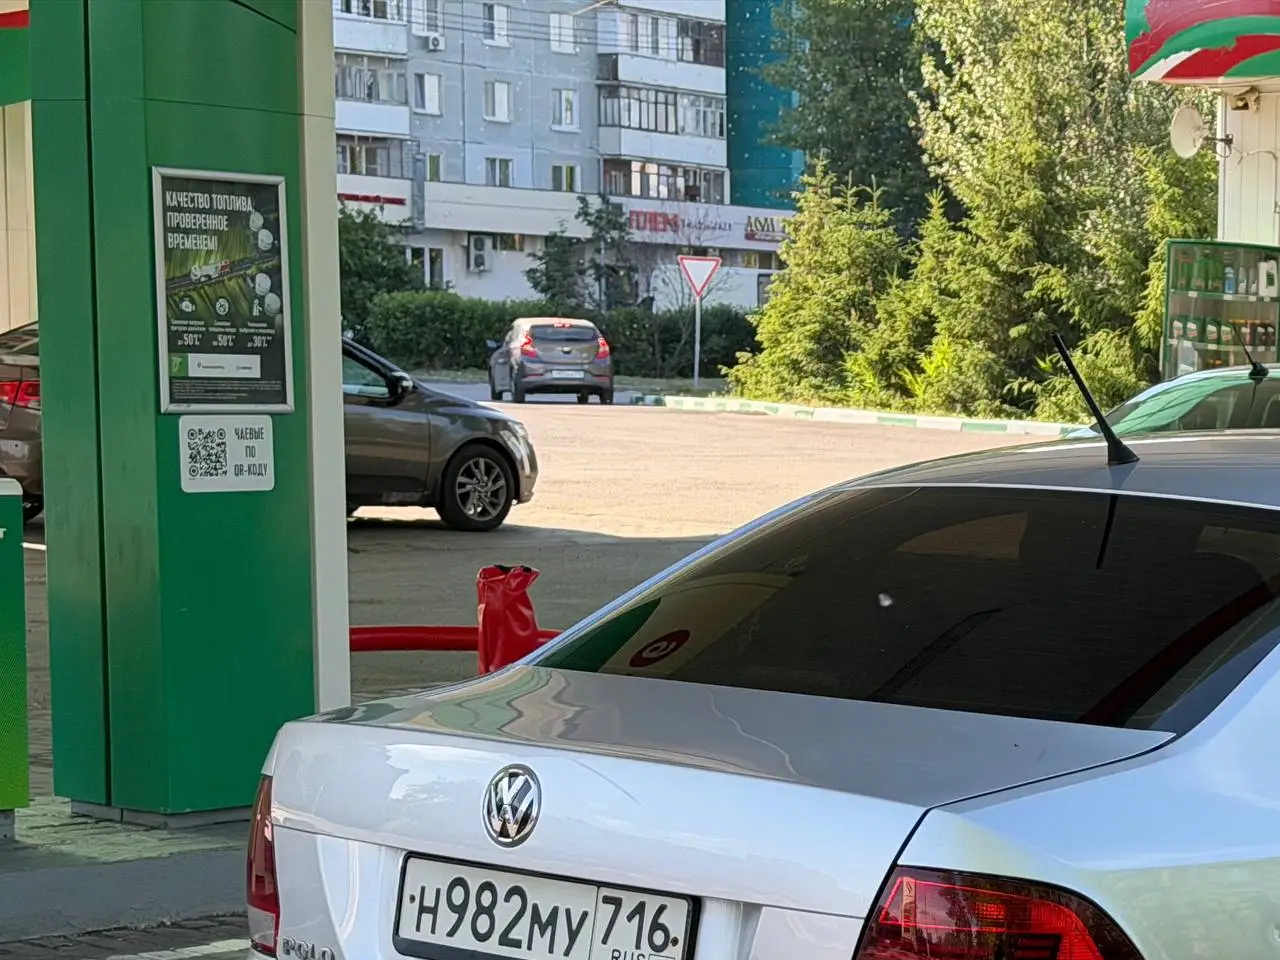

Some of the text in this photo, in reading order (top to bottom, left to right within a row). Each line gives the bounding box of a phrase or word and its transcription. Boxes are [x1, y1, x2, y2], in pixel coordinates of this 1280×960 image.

[165, 190, 210, 210] КАЧЕСТВО
[166, 211, 229, 231] ПРОВЕРЕННОЕ
[167, 232, 218, 251] ВРЕМЕНЕМ!
[234, 427, 265, 441] ЧАЕВЫЕ
[245, 445, 257, 459] ПО
[234, 463, 268, 478] QR-КОДУ
[600, 894, 671, 953] 716
